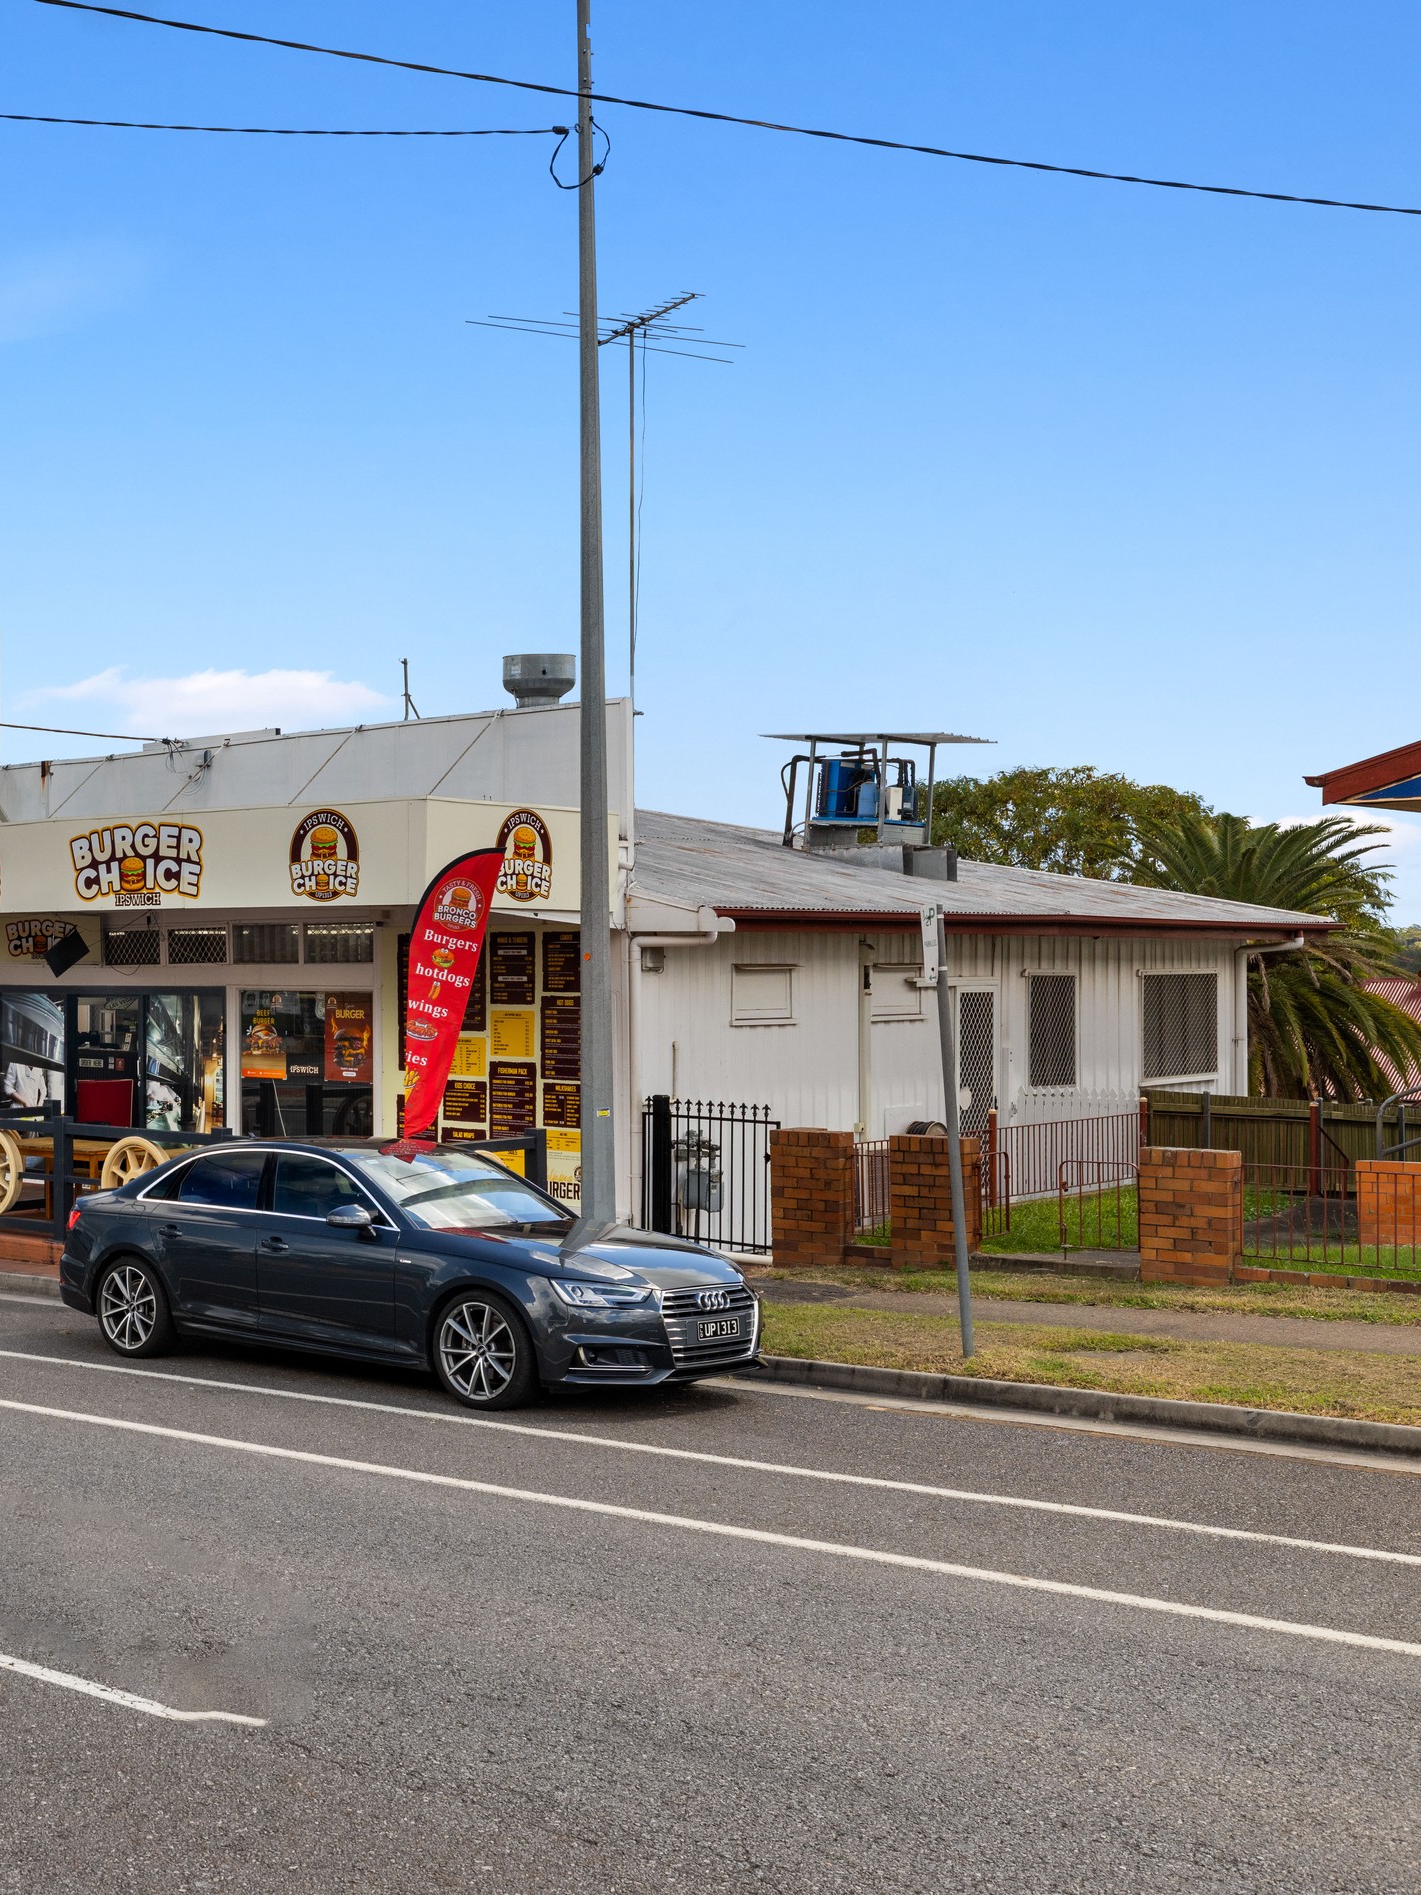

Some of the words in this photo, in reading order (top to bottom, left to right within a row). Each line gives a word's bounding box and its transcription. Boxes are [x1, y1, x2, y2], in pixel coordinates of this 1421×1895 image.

[303, 813, 345, 831] IPSWICH
[507, 813, 542, 831] IPSWICH
[71, 824, 201, 870] BURGER
[291, 859, 358, 879] BURGER
[115, 892, 161, 906] IPSWICH
[437, 904, 477, 920] BRONCO
[433, 912, 477, 929] BURGERS
[424, 928, 478, 953] Burgers
[415, 962, 471, 988] hotdogs
[256, 1009, 271, 1017] BEEF
[335, 1009, 365, 1020] BURGER
[408, 998, 449, 1018] wings
[252, 1017, 275, 1025] BURGER
[405, 1052, 428, 1066] ries
[290, 1065, 319, 1074] IPSWICH
[497, 1067, 517, 1075] FISHERMAN
[454, 1082, 462, 1090] KIDS
[462, 1082, 476, 1090] CHOICE
[452, 1131, 463, 1139] SALAD
[704, 1320, 737, 1337] UP1313
